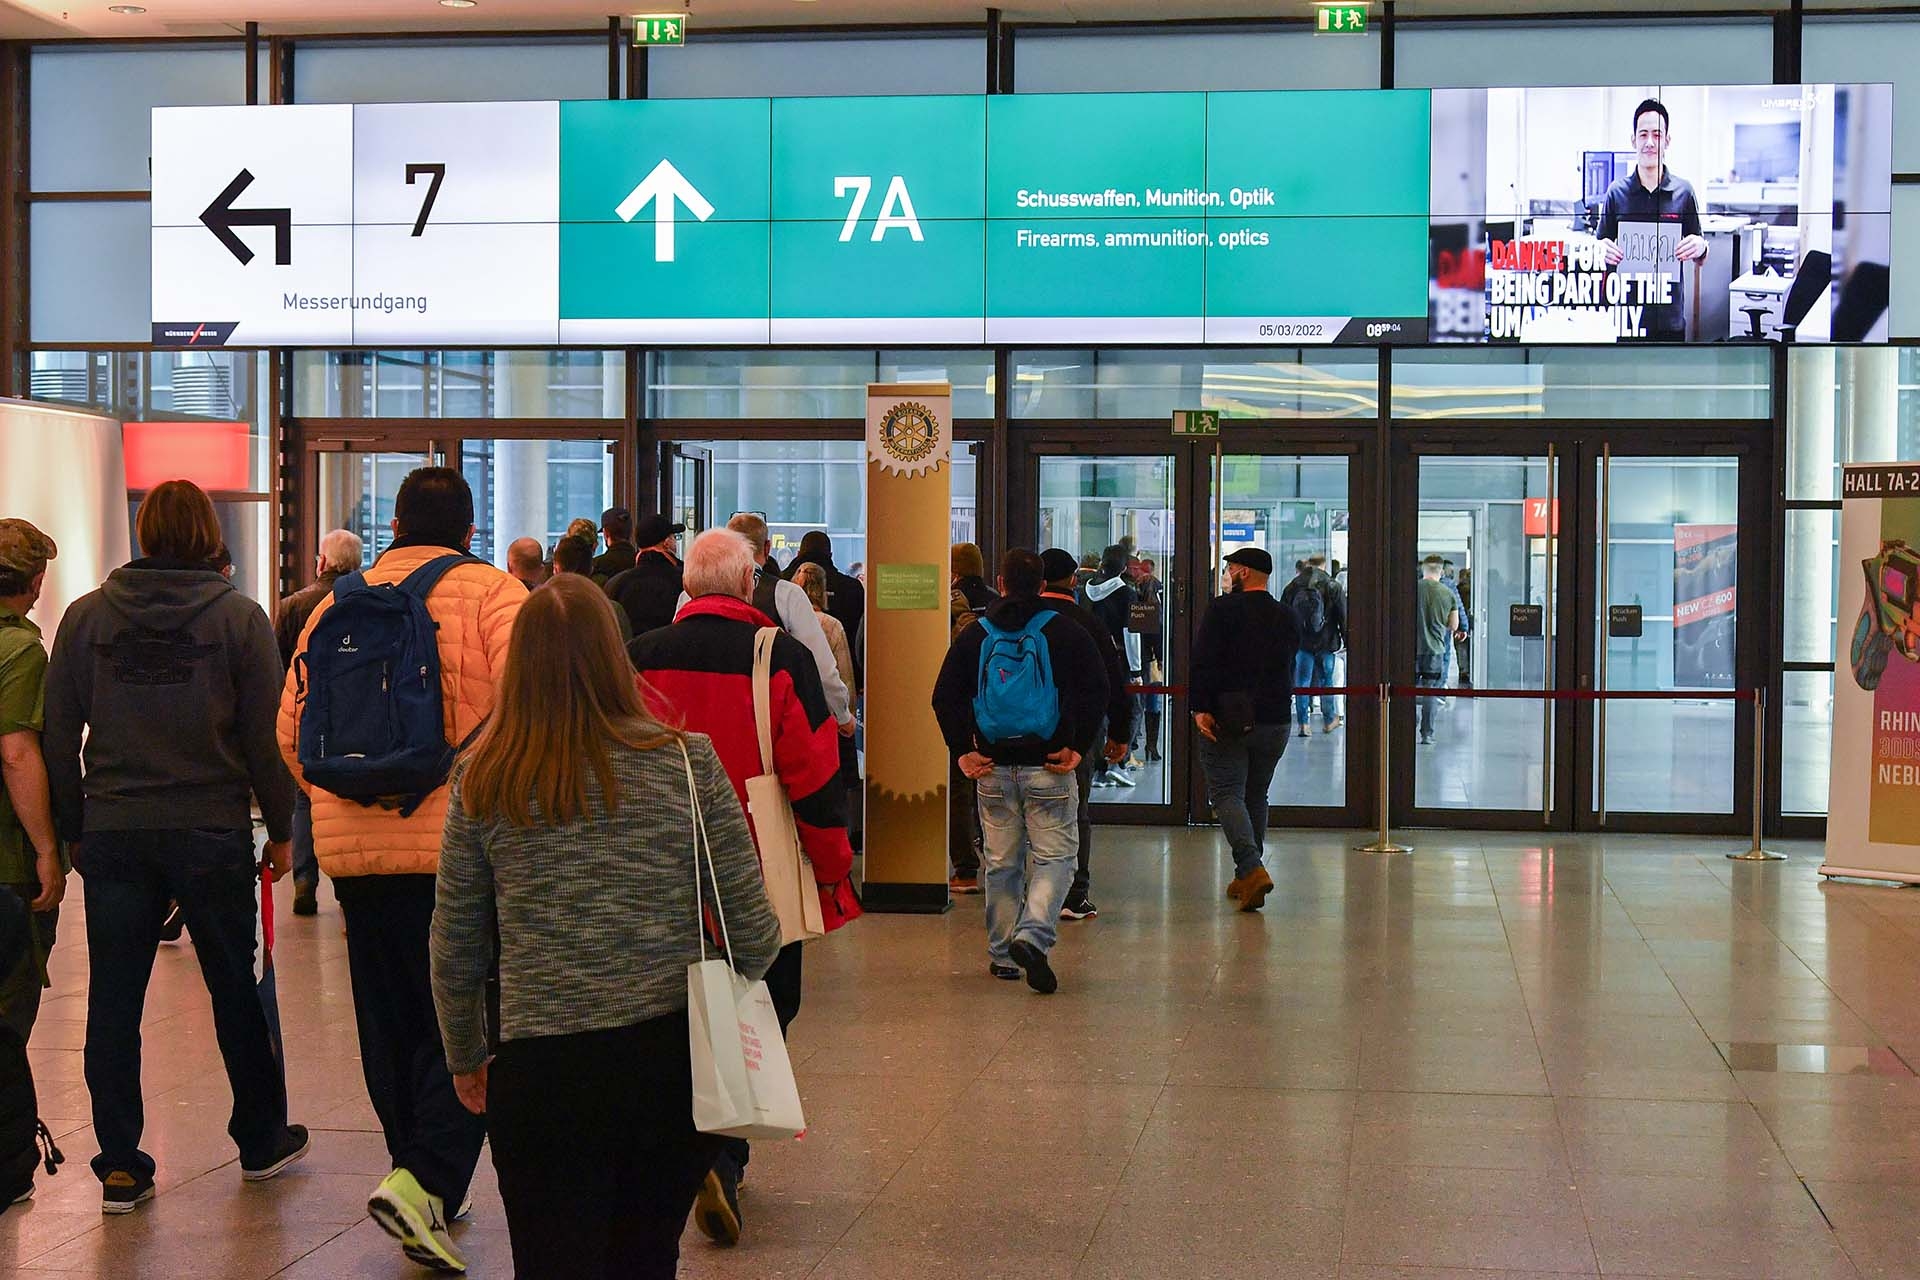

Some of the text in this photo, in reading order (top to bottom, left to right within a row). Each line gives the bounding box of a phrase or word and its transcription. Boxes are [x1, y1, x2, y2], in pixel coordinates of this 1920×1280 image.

[405, 163, 446, 237] 7
[833, 175, 925, 242] 7A
[1016, 187, 1276, 209] Schusswaffen, Munition, Optik
[1016, 228, 1270, 249] Firearms, ammunition, optics
[1492, 240, 1607, 272] DANKE! FOR
[1491, 272, 1672, 305] BEING PART OF THE
[283, 292, 427, 314] Messerundgang
[1258, 324, 1323, 337] 05/03/2022
[1845, 473, 1882, 492] HALL
[1676, 601, 1700, 617] NEW
[1715, 590, 1733, 605] 600
